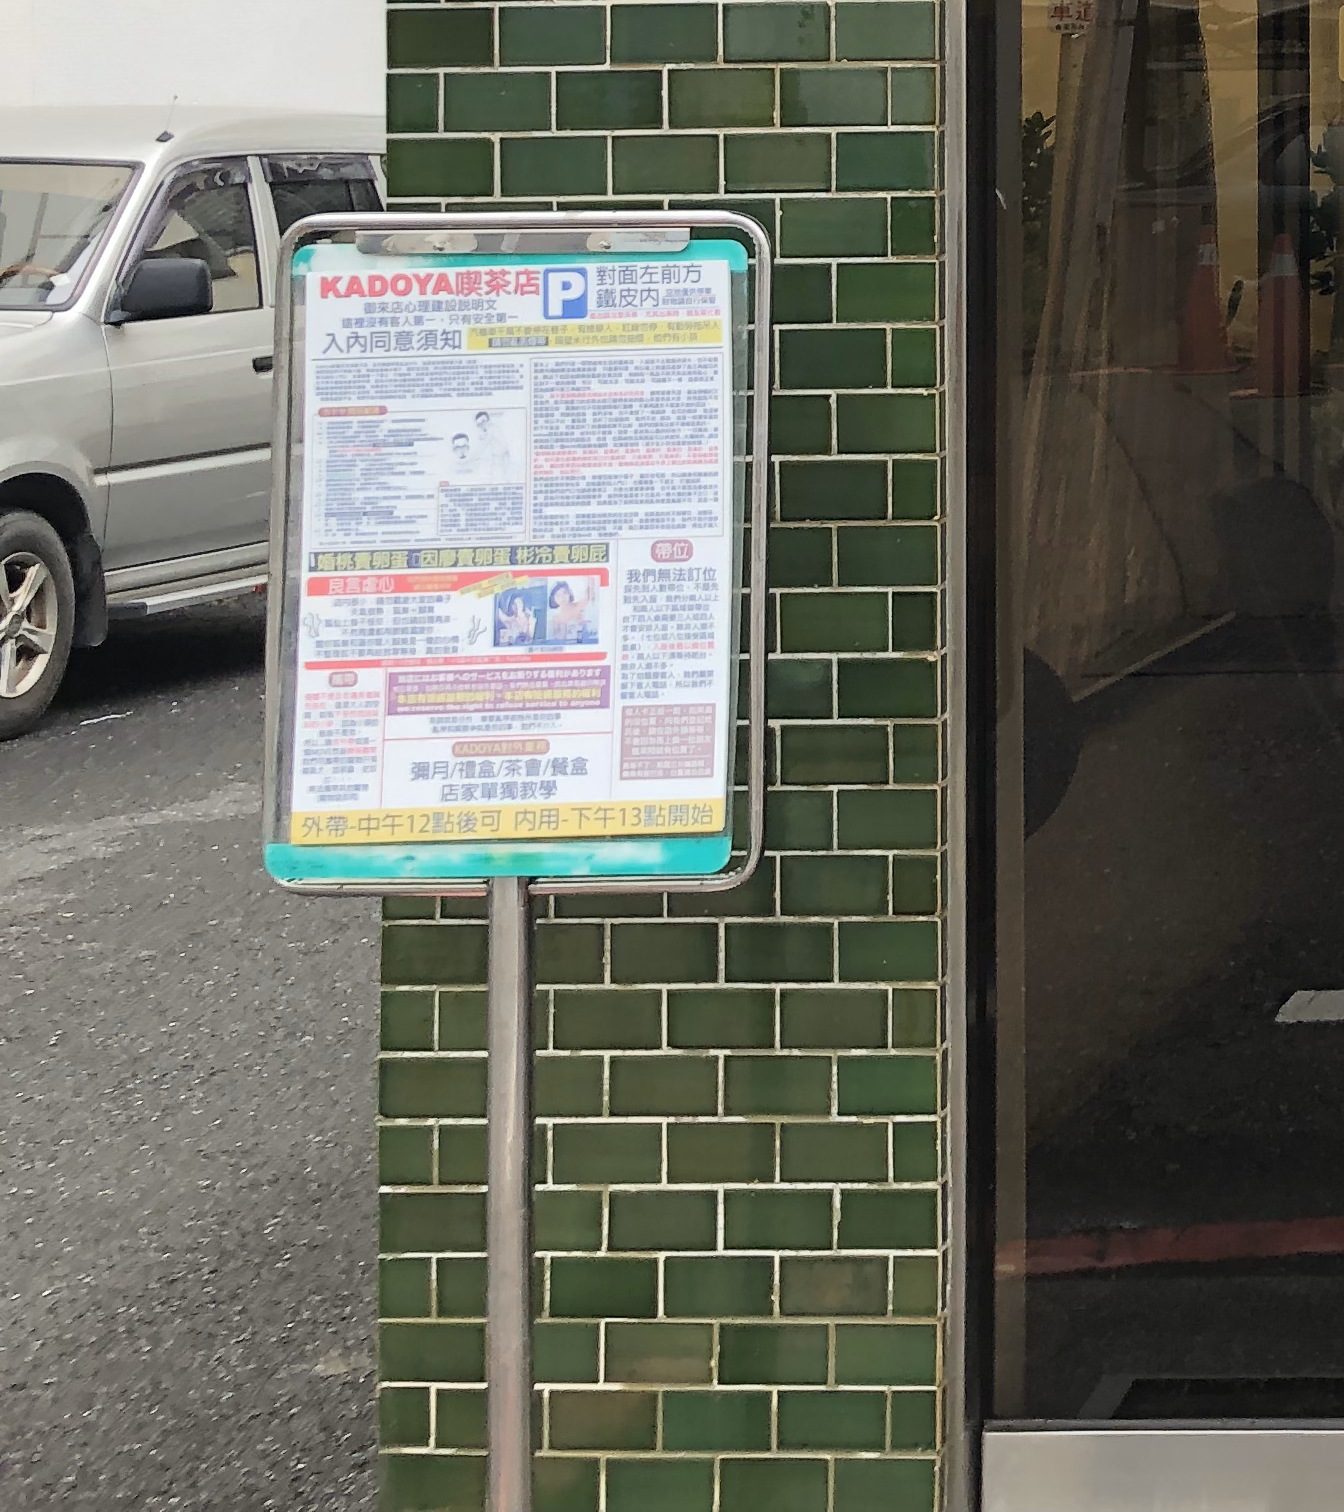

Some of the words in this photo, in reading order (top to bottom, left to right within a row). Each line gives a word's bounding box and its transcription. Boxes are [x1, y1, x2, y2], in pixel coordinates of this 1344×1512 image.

[596, 263, 703, 286] 對面左前方
[596, 288, 659, 308] 鐵皮內
[322, 329, 462, 354] 入內同意須知
[655, 542, 689, 559] 帶位
[626, 567, 717, 584] 我們無法訂位
[440, 780, 558, 803] 店家單獨教學
